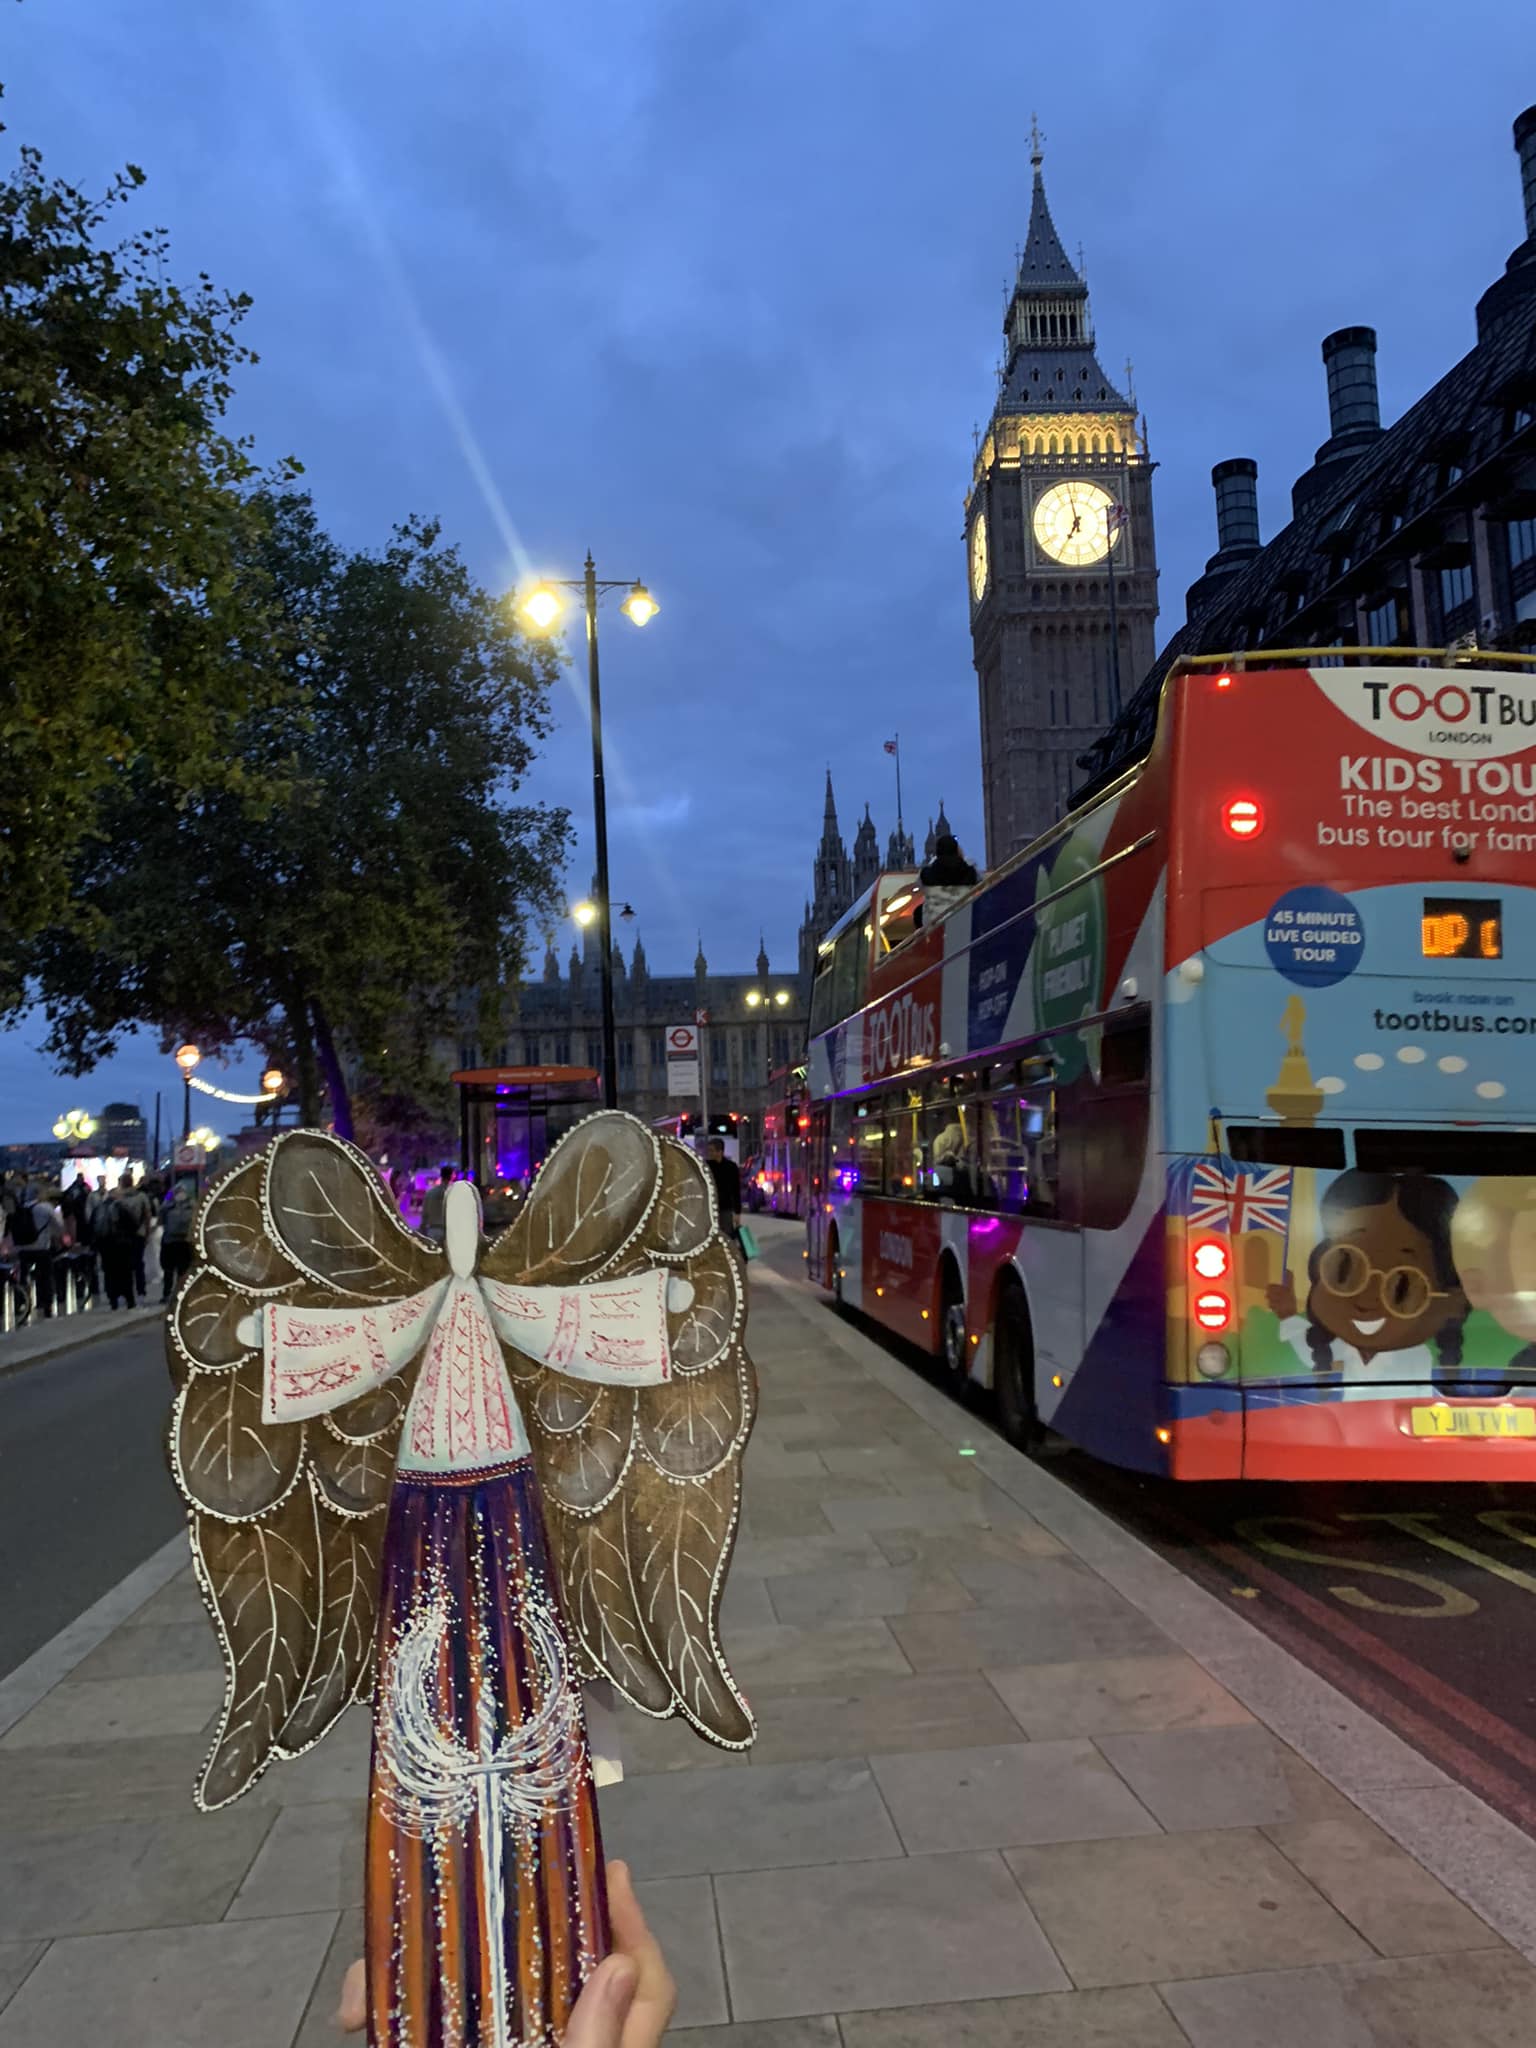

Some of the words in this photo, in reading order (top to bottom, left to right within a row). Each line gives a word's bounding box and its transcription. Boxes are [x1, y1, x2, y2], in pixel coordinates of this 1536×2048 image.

[1429, 731, 1492, 744] LONDON
[1340, 756, 1443, 793] KIDS
[1341, 794, 1393, 818] The
[1401, 796, 1462, 820] best
[1318, 821, 1370, 846] bus
[1377, 825, 1434, 848] tour
[1441, 825, 1480, 849] for
[1273, 911, 1294, 924] 45
[1296, 912, 1356, 927] MINUTE
[1267, 929, 1300, 942] LIVE
[1302, 930, 1361, 945] GUIDED
[1293, 947, 1336, 962] TOUR
[1414, 991, 1454, 1004] book
[1457, 994, 1491, 1005] now
[1495, 995, 1515, 1006] on
[696, 1010, 707, 1024] K
[1374, 1009, 1536, 1035] tootbus.co
